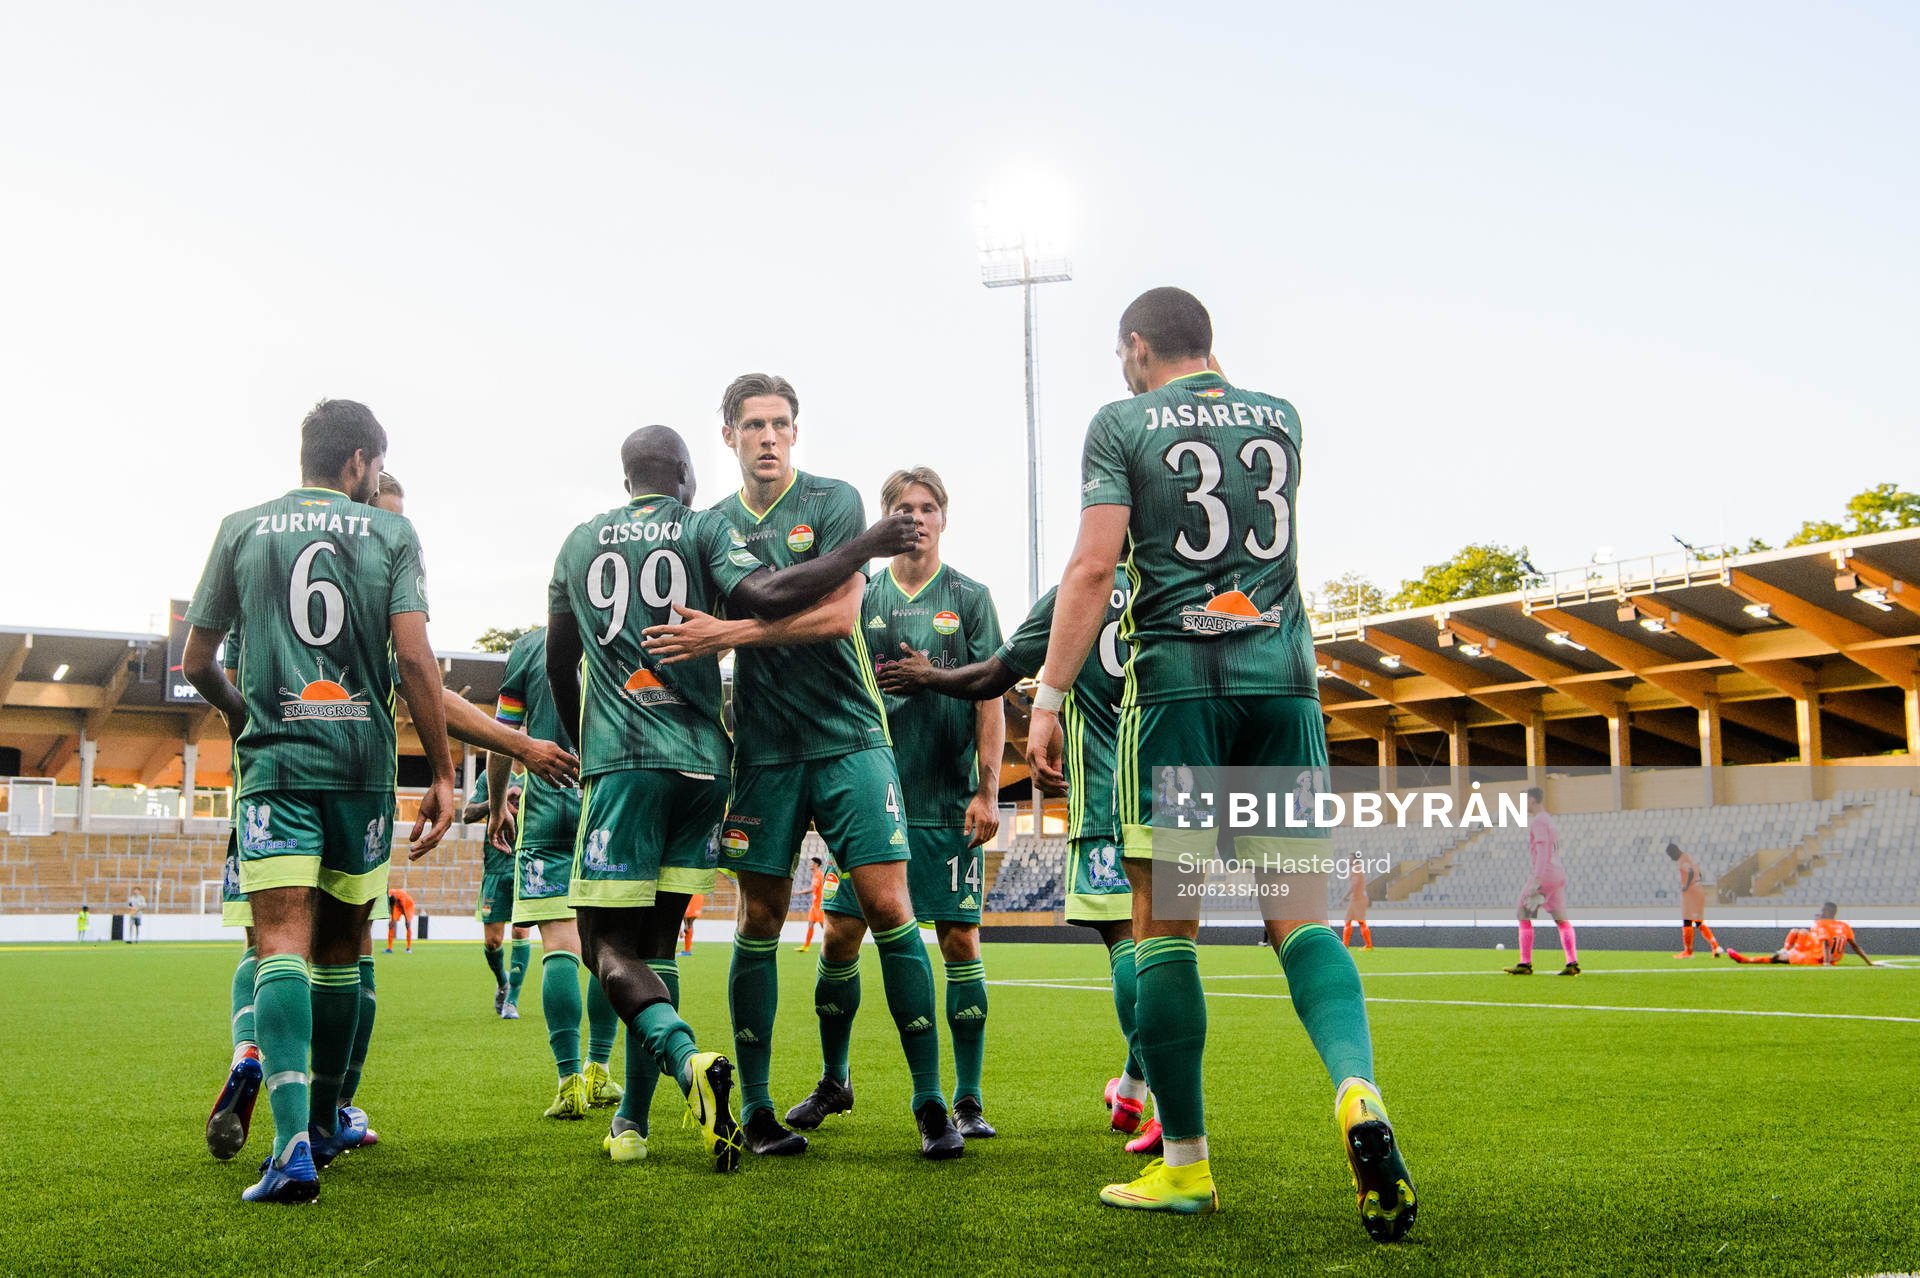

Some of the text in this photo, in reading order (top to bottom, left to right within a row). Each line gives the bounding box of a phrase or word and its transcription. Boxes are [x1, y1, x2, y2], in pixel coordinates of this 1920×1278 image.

[1145, 401, 1290, 434] JASAREVIC
[1163, 437, 1292, 562] 33
[255, 512, 372, 537] ZURMATI
[598, 521, 683, 545] CISSOKO
[288, 540, 346, 647] 6
[586, 548, 689, 646] 99
[284, 704, 368, 717] SNABBGROSS
[885, 782, 901, 823] 4
[946, 855, 981, 893] 14
